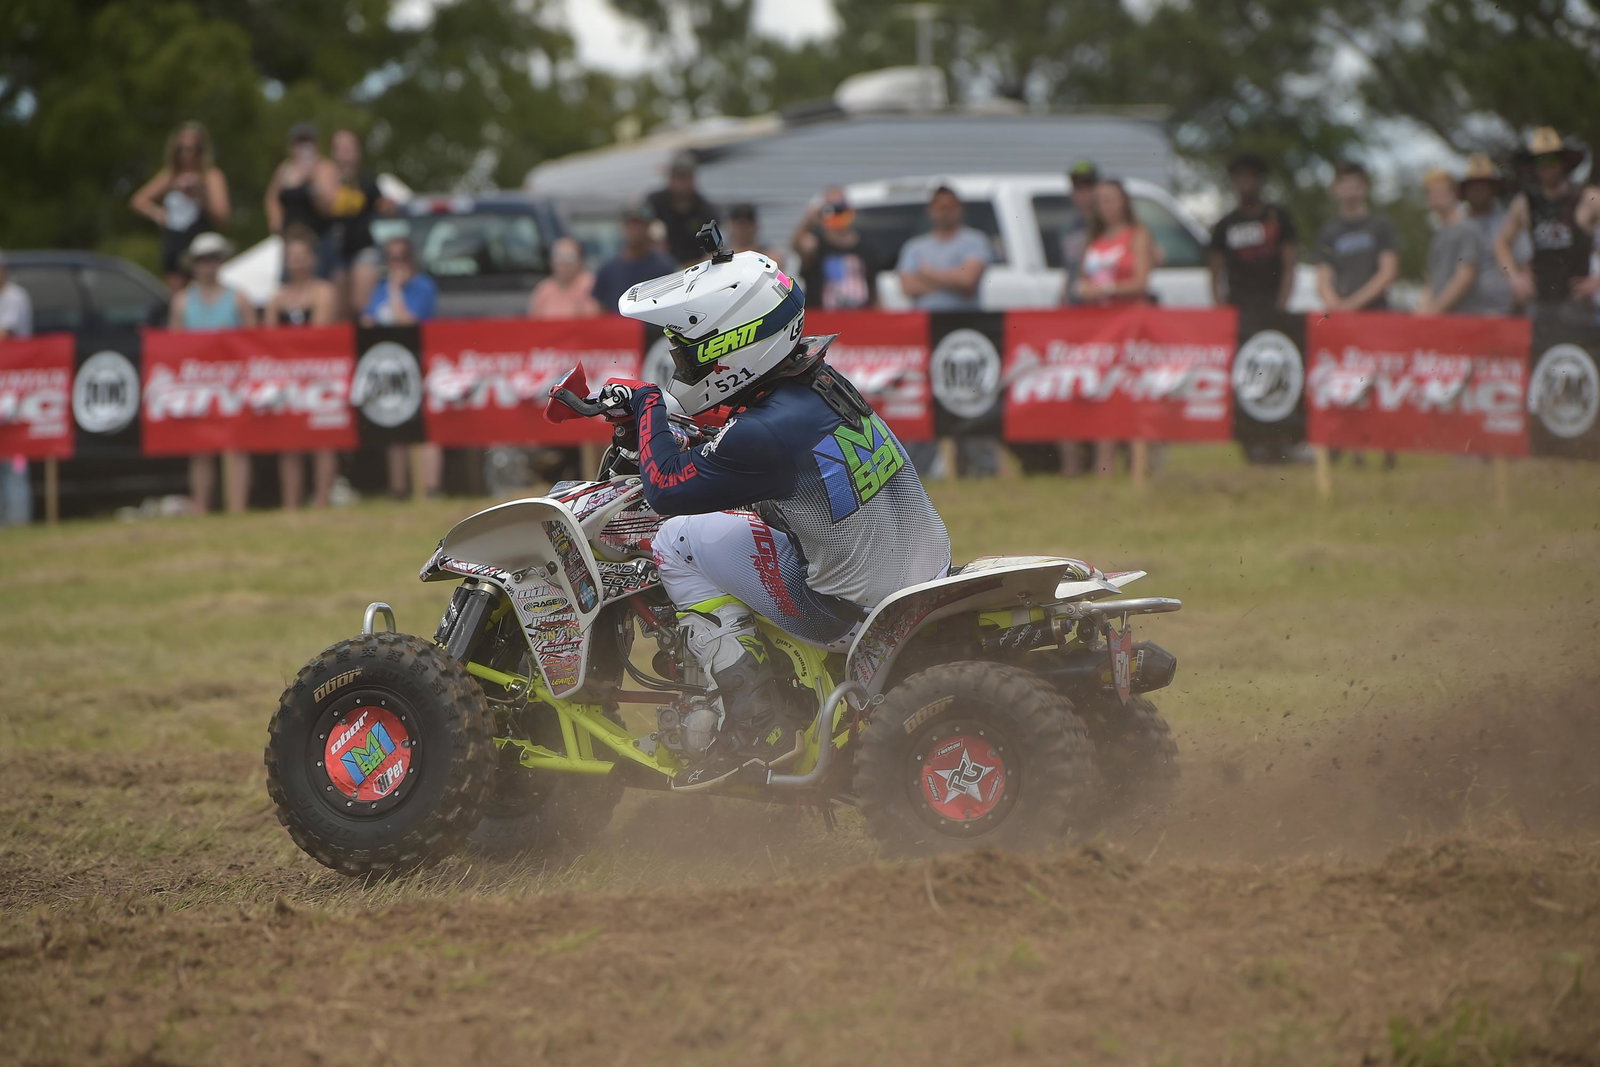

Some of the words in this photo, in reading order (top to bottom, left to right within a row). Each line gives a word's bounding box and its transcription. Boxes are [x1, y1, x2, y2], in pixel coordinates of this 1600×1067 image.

[697, 319, 764, 363] LEATT
[715, 367, 756, 393] 521
[645, 460, 698, 490] RACING
[853, 437, 904, 502] 521
[533, 599, 558, 609] RAGE
